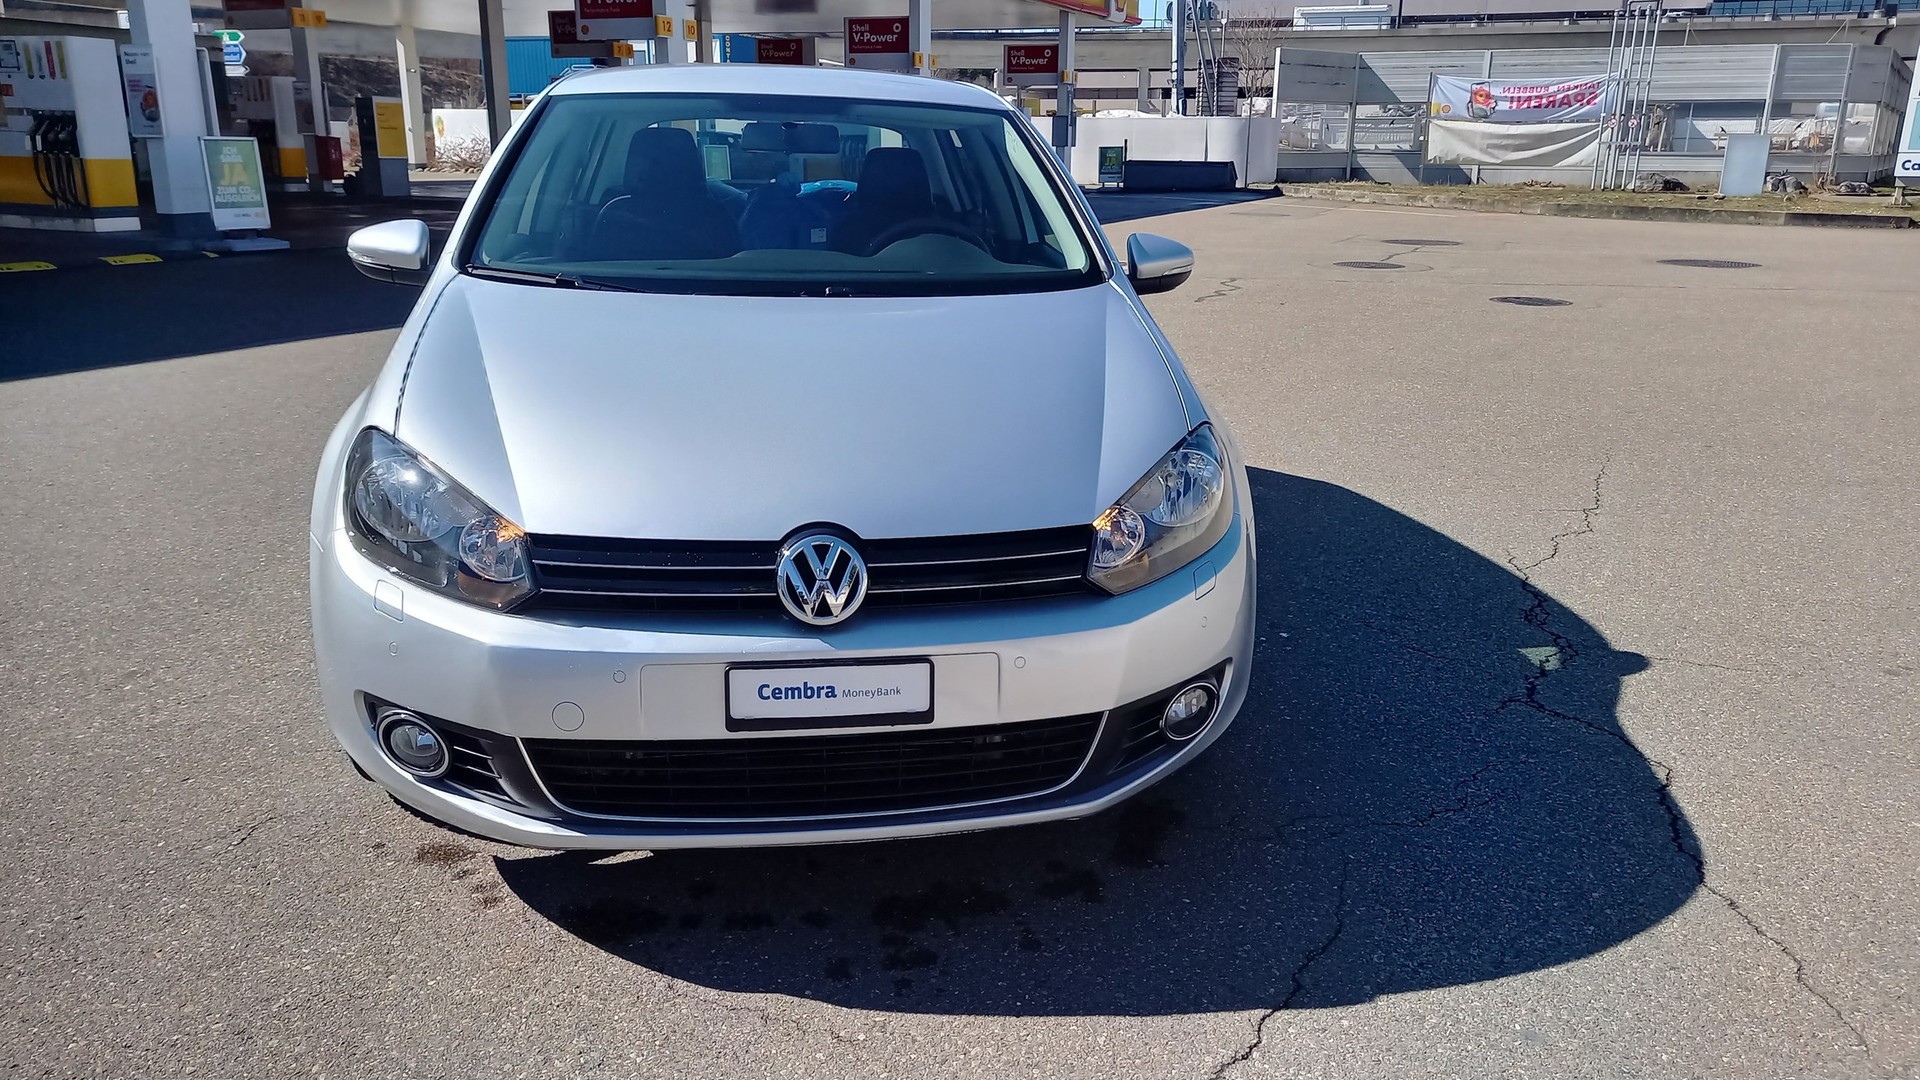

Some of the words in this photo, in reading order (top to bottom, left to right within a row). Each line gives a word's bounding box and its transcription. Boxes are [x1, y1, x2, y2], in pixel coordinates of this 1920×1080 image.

[555, 25, 577, 34] V-Po
[662, 20, 671, 32] 12
[687, 25, 695, 35] 10
[852, 23, 870, 31] Shell
[852, 32, 898, 42] V-Power
[761, 49, 794, 57] V-Power
[1010, 56, 1048, 65] V-Power
[778, 535, 867, 625] VW
[757, 681, 837, 700] Cembra
[842, 686, 902, 699] MoneyBank
